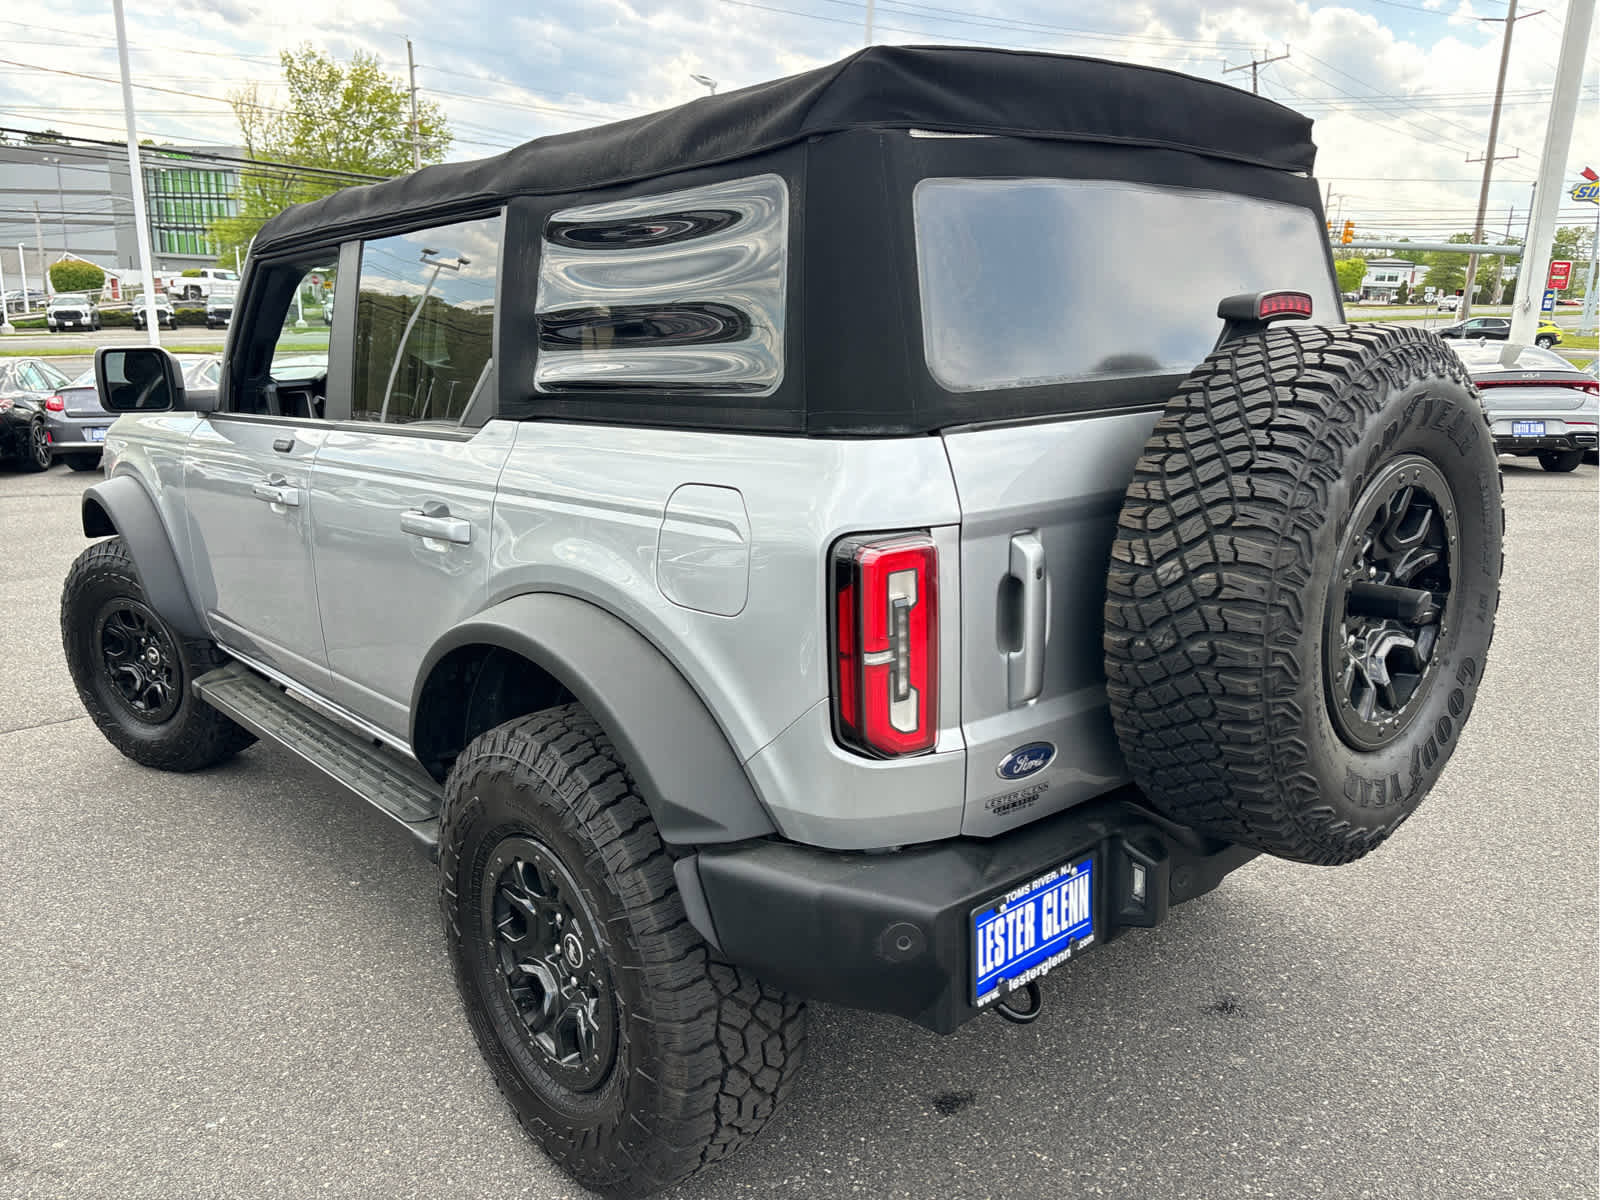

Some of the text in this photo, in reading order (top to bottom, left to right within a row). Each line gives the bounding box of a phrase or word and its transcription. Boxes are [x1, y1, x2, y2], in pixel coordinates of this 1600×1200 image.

[1013, 752, 1045, 774] Ford
[1005, 882, 1031, 903] TOMS
[1060, 863, 1072, 875] NJ
[977, 873, 1090, 978] LESTER GLENN
